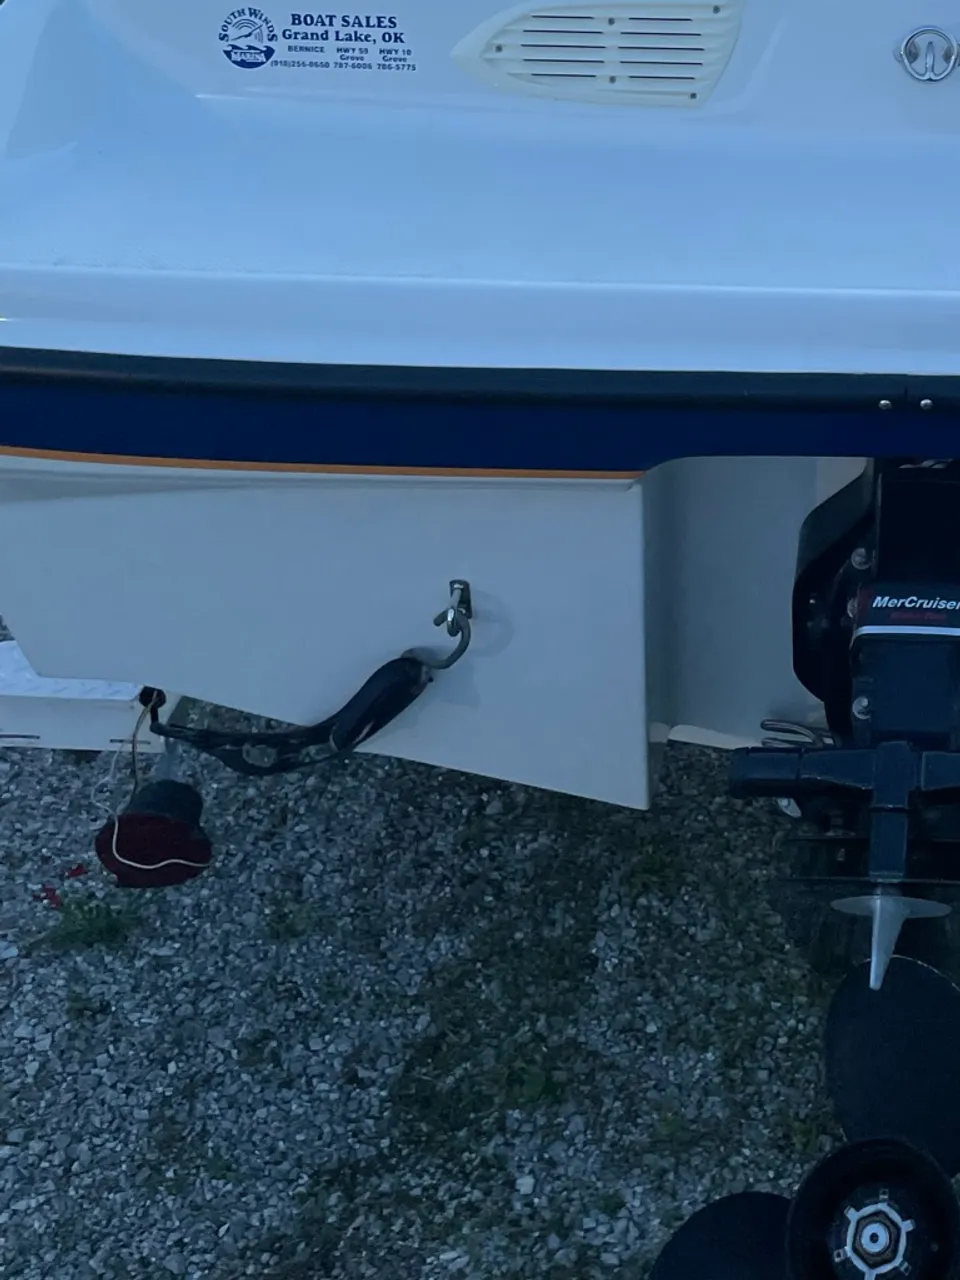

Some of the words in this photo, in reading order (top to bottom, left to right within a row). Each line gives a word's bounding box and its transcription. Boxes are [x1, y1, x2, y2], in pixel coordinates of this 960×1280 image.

[218, 7, 247, 42] SOUTH
[247, 6, 279, 42] WINDS
[290, 13, 337, 27] BOAT
[341, 15, 398, 29] SALES
[281, 28, 330, 41] Grand
[334, 30, 377, 45] Lake,
[381, 32, 406, 44] OK
[287, 44, 325, 54] BERNICE
[336, 46, 356, 55] HWY
[378, 48, 400, 56] HWY
